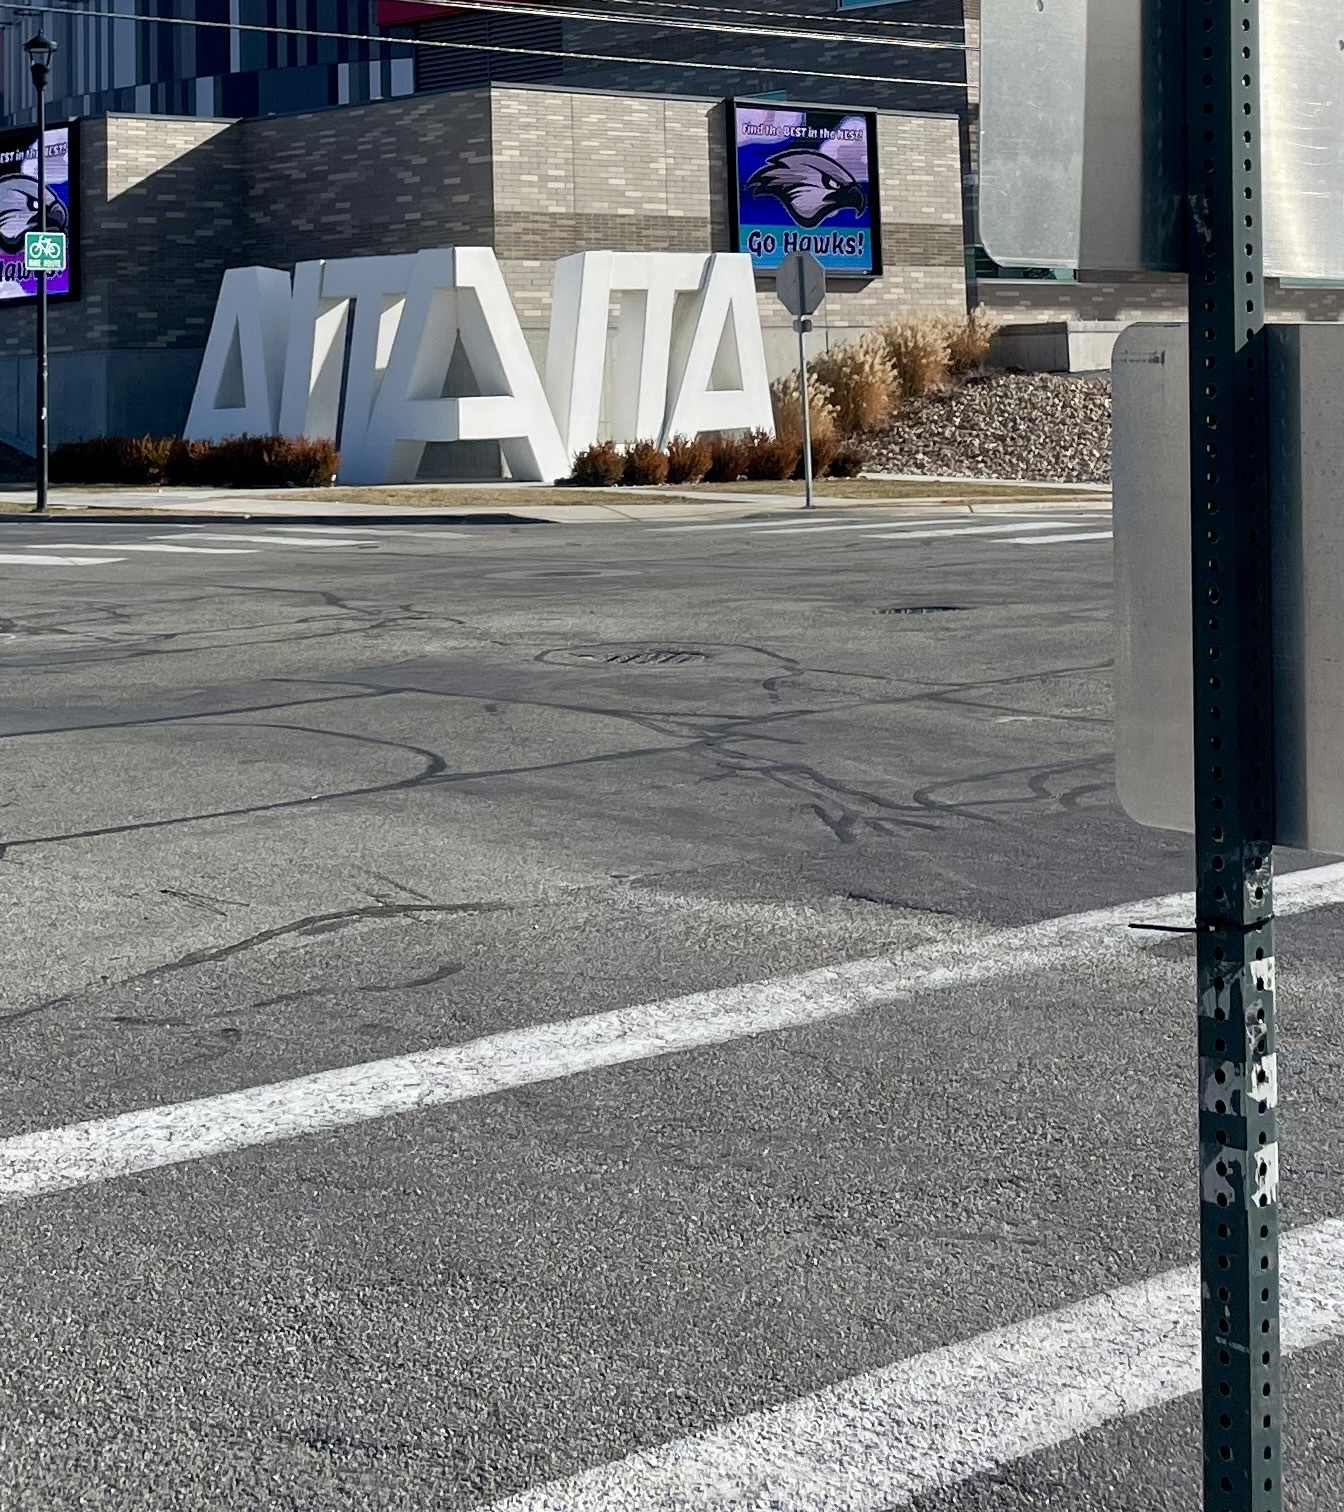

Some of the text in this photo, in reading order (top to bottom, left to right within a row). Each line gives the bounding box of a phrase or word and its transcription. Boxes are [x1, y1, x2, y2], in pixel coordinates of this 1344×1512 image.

[742, 123, 763, 135] Find
[783, 127, 807, 138] BEST
[808, 127, 817, 138] in
[819, 128, 836, 140] the
[747, 229, 865, 258] Go Hawks!
